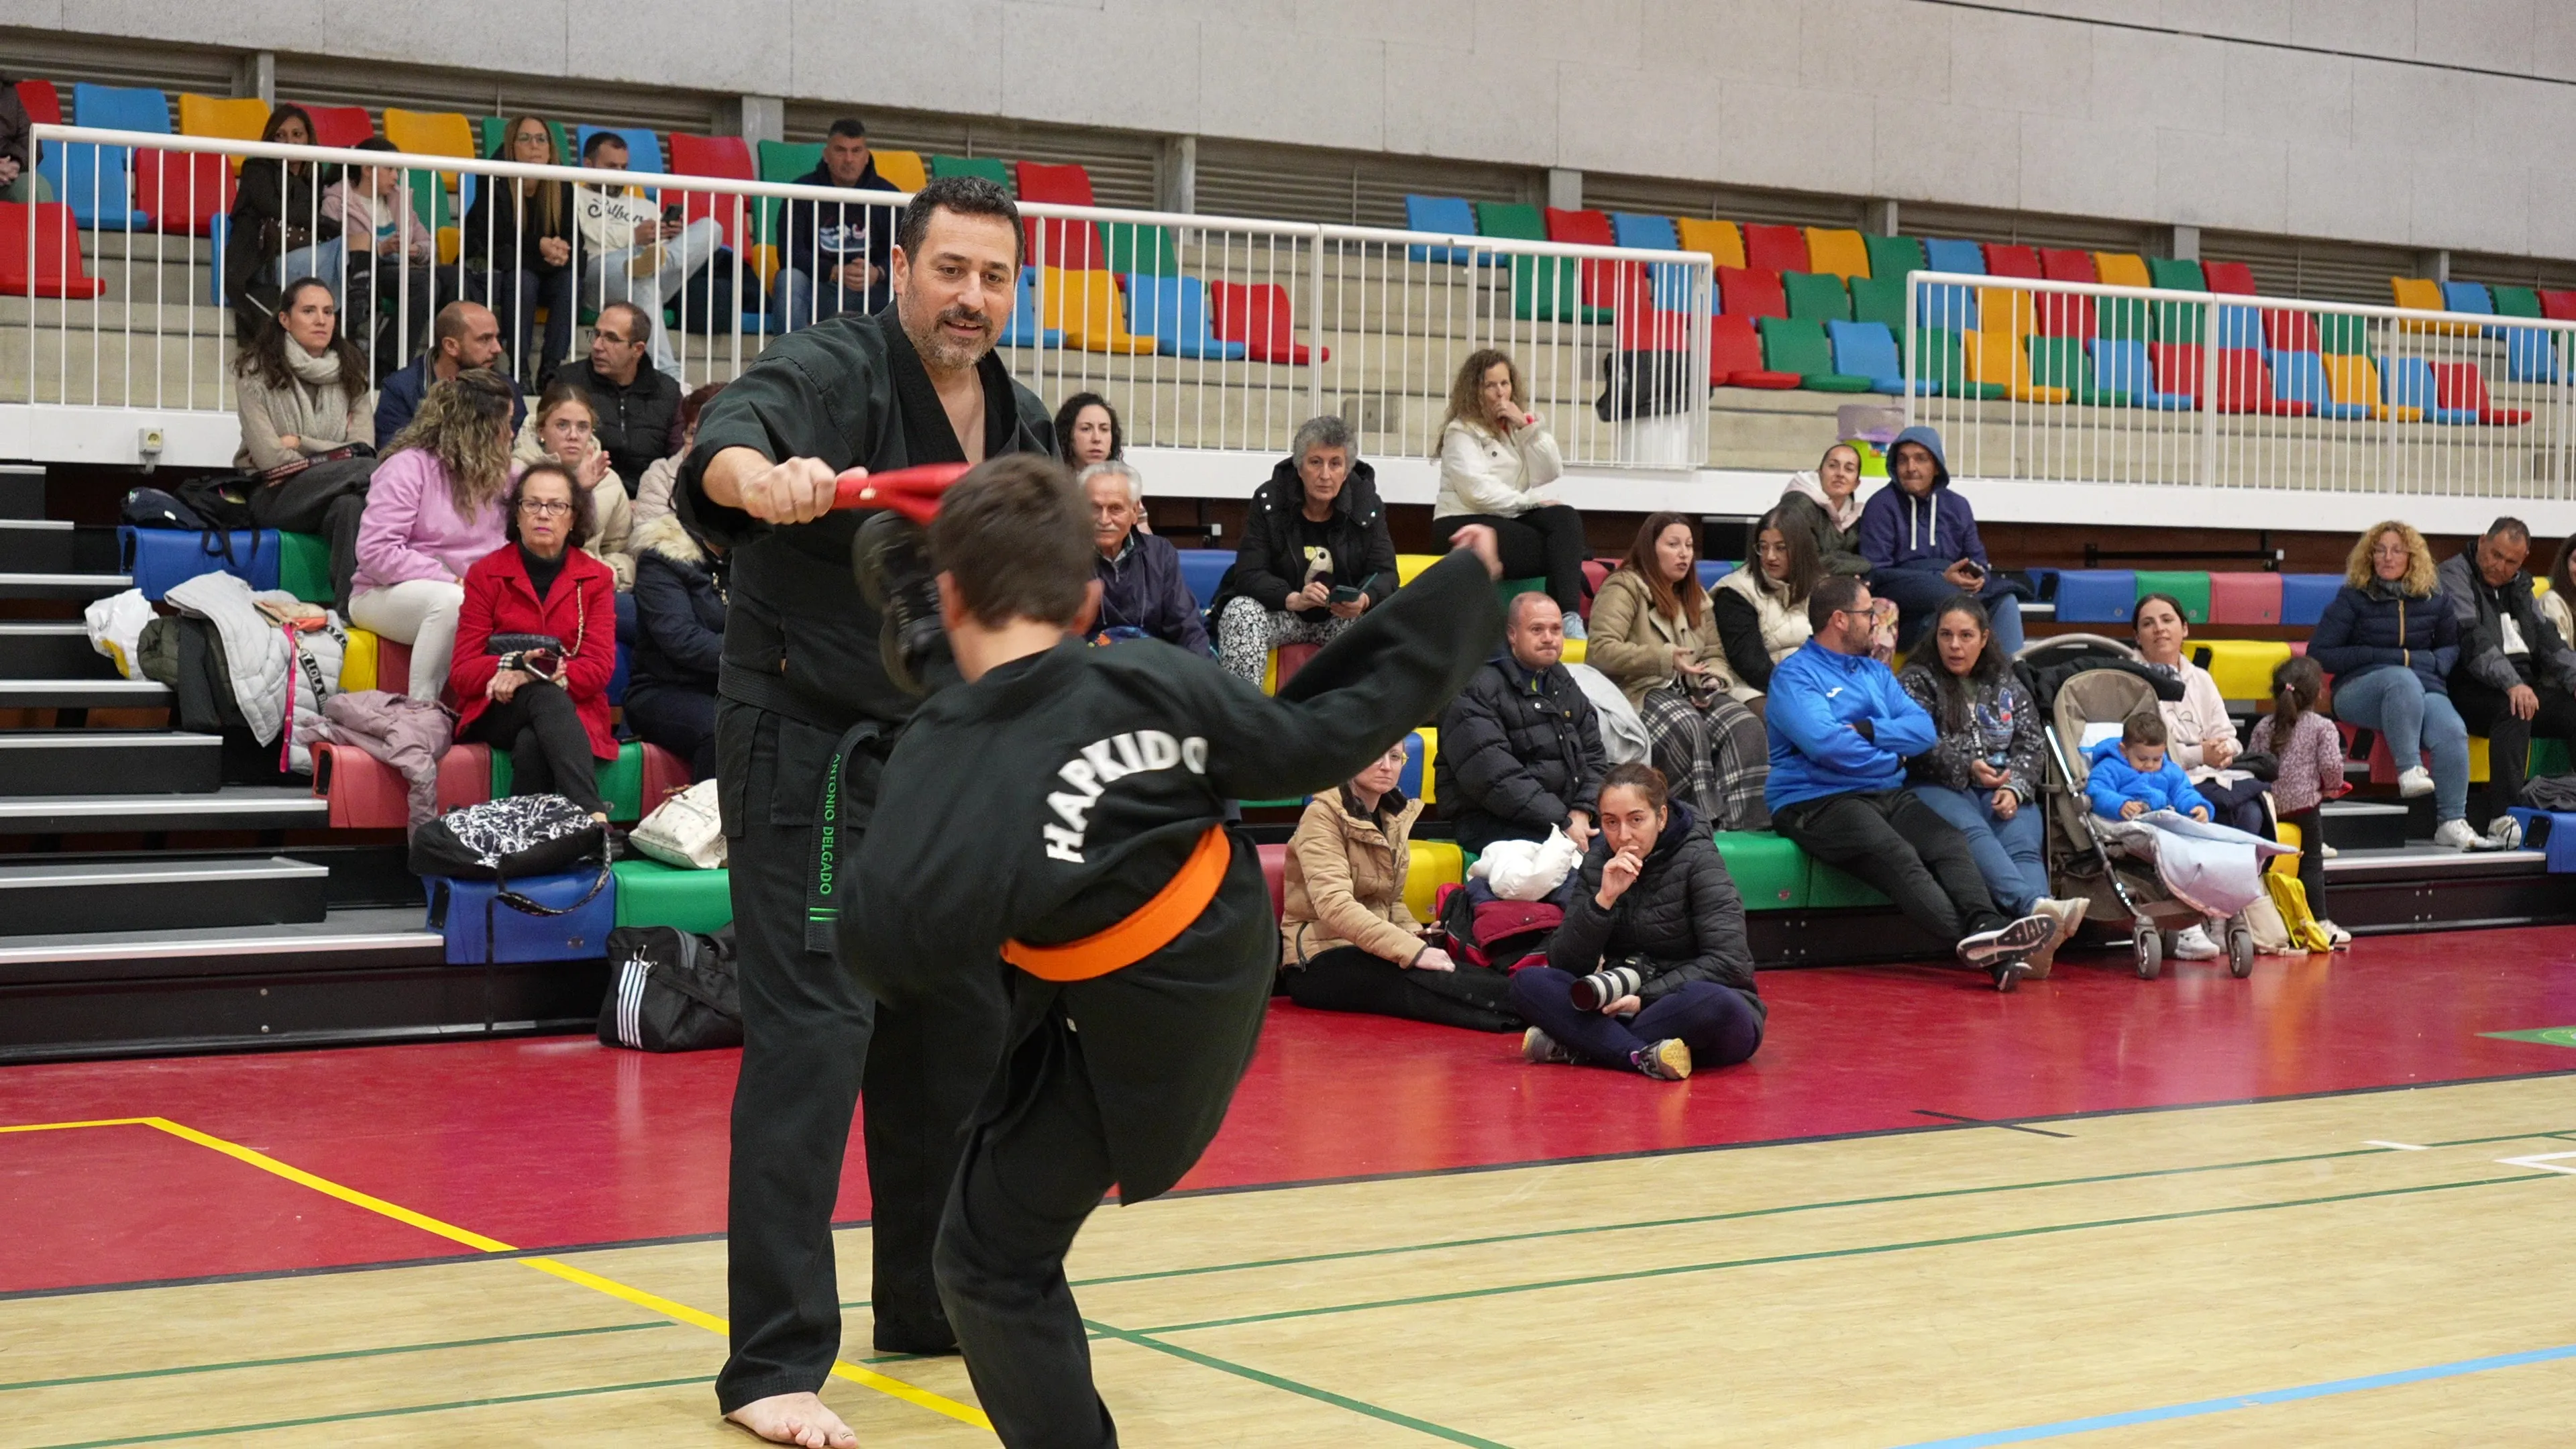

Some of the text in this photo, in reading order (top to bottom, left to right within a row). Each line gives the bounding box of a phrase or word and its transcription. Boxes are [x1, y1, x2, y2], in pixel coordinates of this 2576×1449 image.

[307, 663, 323, 692] LOLA
[820, 753, 841, 896] ANTONIO DELGADO
[1043, 730, 1208, 863] HAPKIDO
